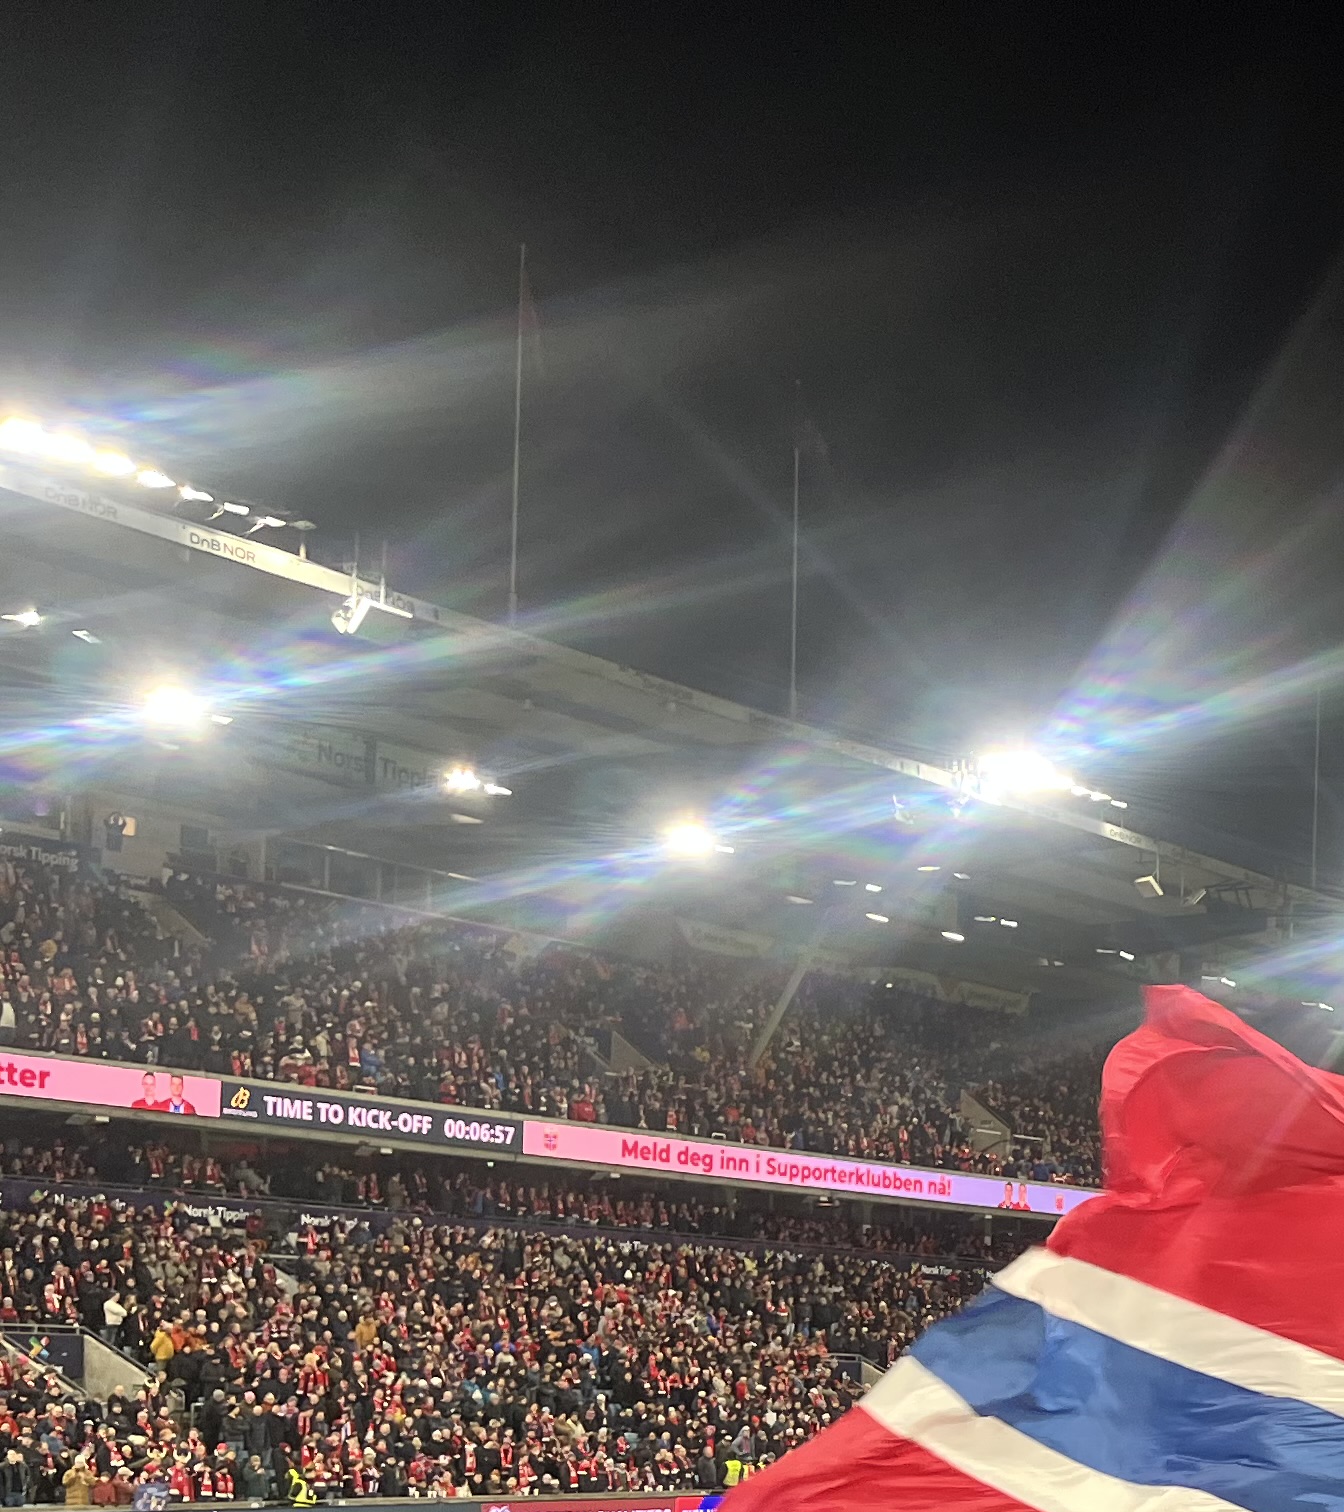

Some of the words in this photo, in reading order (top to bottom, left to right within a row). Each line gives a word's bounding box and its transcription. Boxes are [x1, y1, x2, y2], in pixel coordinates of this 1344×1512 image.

[223, 543, 257, 563] NOR
[263, 1096, 312, 1121] TIME
[317, 1103, 344, 1124] TO
[348, 1107, 433, 1135] KICK-OFF
[443, 1118, 516, 1145] 00:06:57
[621, 1139, 670, 1163] Meld
[677, 1146, 713, 1173] deg
[720, 1150, 749, 1173] inn
[755, 1153, 760, 1174] i
[766, 1157, 923, 1193] Supporterklubben
[927, 1174, 952, 1197] nå!
